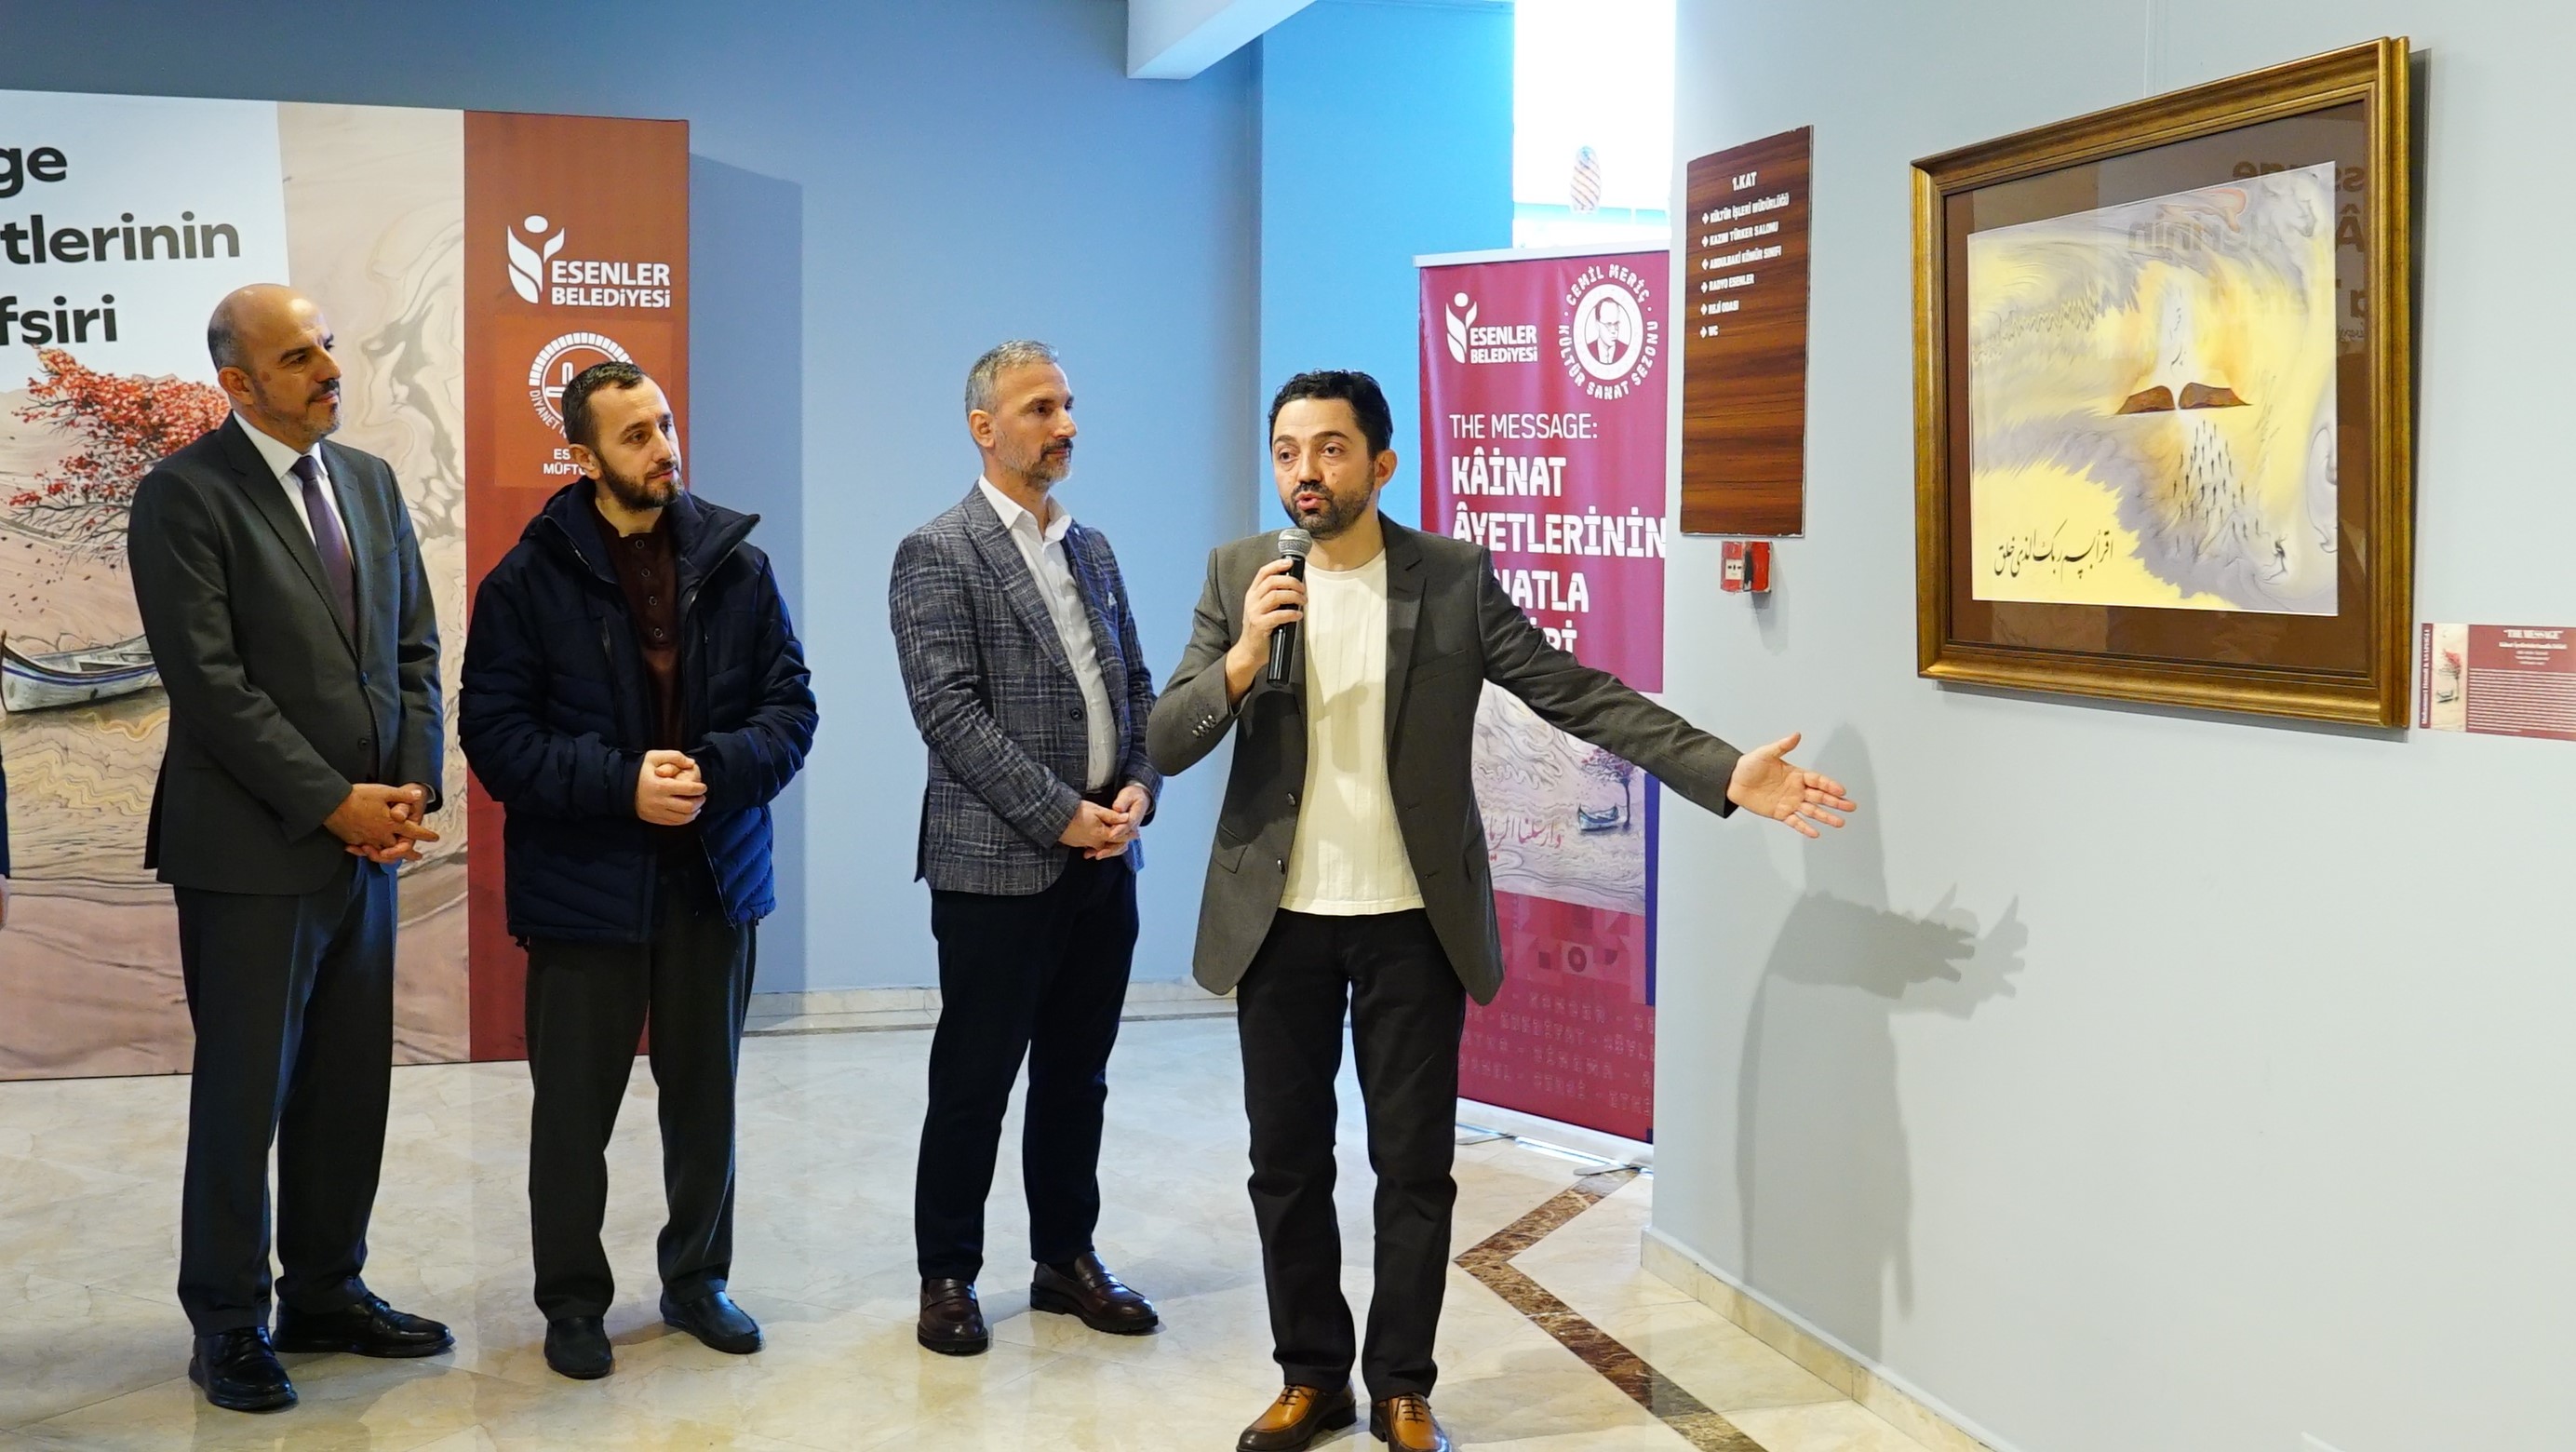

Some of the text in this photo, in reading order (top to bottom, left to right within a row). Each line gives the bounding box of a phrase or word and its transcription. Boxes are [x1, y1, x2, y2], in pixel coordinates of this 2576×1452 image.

[1732, 172, 1757, 191] 1.KAT
[1710, 207, 1732, 223] KÜLTÜR
[0, 211, 240, 264] tlerinin
[552, 261, 670, 286] ESENLER
[1565, 263, 1650, 306] CEMİL MERİÇ
[0, 294, 117, 346] fsiri
[1470, 325, 1537, 346] ESENLER
[1558, 320, 1658, 400] KÜLTÜR SANAT SEZONU
[1449, 413, 1598, 438] THE MESSAGE:
[1452, 446, 1566, 496] KÂİNAT
[1453, 502, 1666, 558] ÂYETLERİNİN
